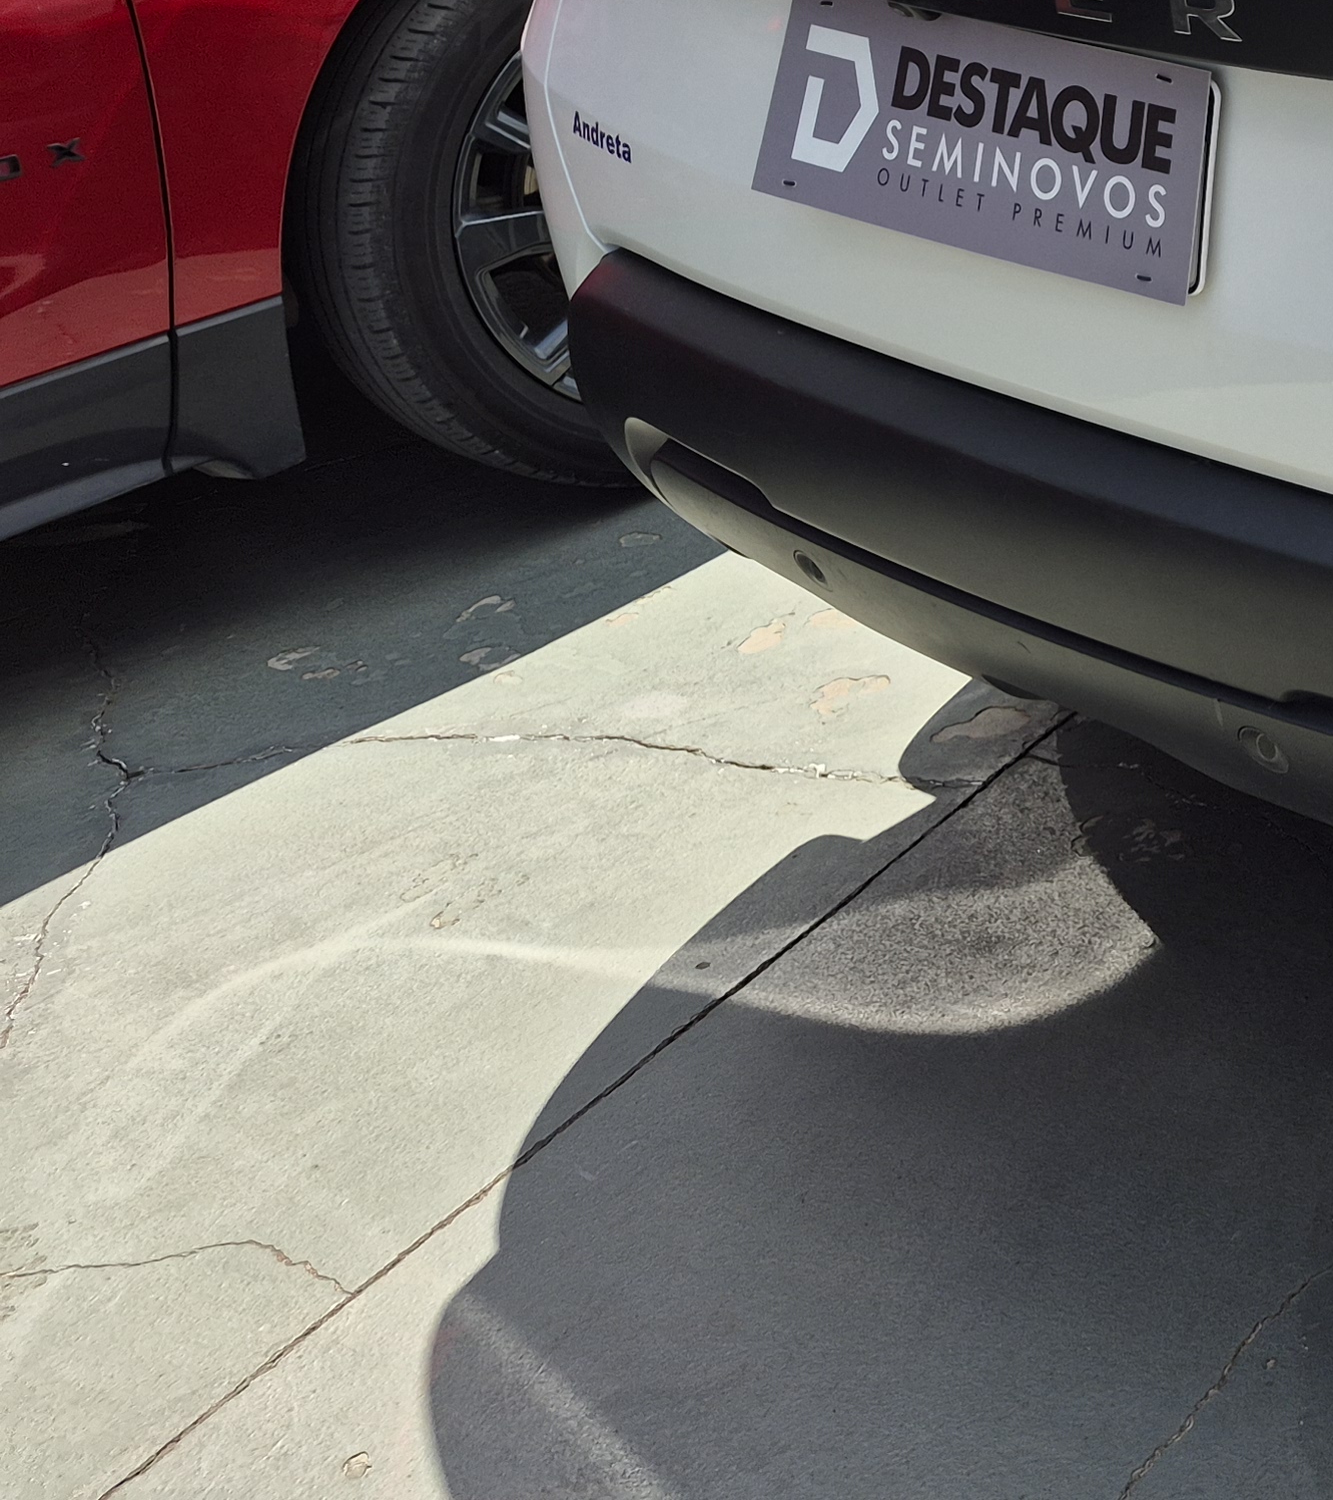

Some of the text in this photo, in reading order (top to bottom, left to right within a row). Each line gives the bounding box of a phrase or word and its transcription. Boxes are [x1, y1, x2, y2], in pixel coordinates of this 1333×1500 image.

[573, 110, 632, 164] Andreta
[890, 45, 1177, 175] DESTAQUE
[877, 167, 1163, 258] OUTLET PREMIUM
[881, 119, 1167, 228] SEMINOVOS
